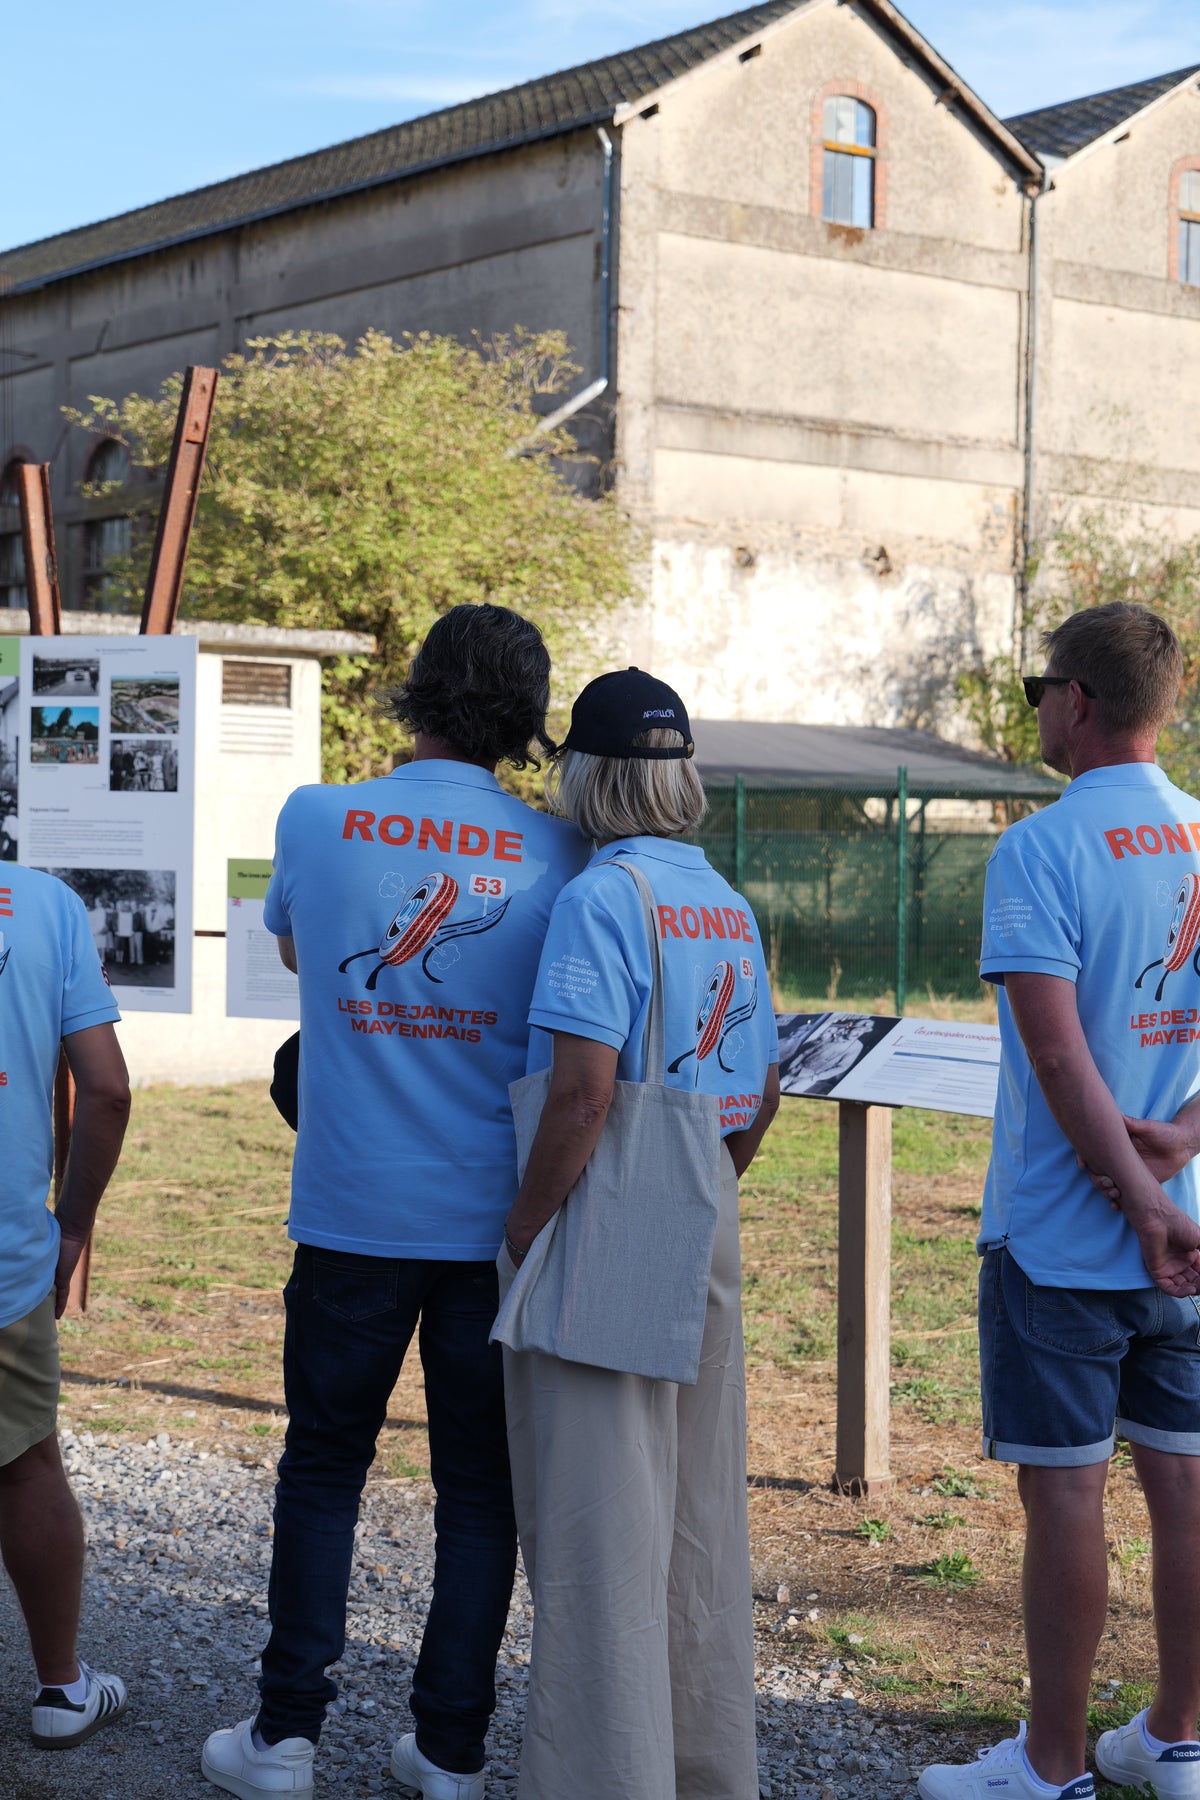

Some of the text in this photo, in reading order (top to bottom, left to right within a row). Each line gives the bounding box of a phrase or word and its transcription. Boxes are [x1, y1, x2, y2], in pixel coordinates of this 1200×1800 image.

[343, 810, 524, 863] RONDE
[474, 877, 502, 896] 53
[657, 905, 755, 943] RONDE
[742, 959, 754, 977] 53
[338, 998, 498, 1025] LES DEJANTES
[1130, 1009, 1200, 1029] LES DEJ
[351, 1018, 481, 1043] MAYENNAIS
